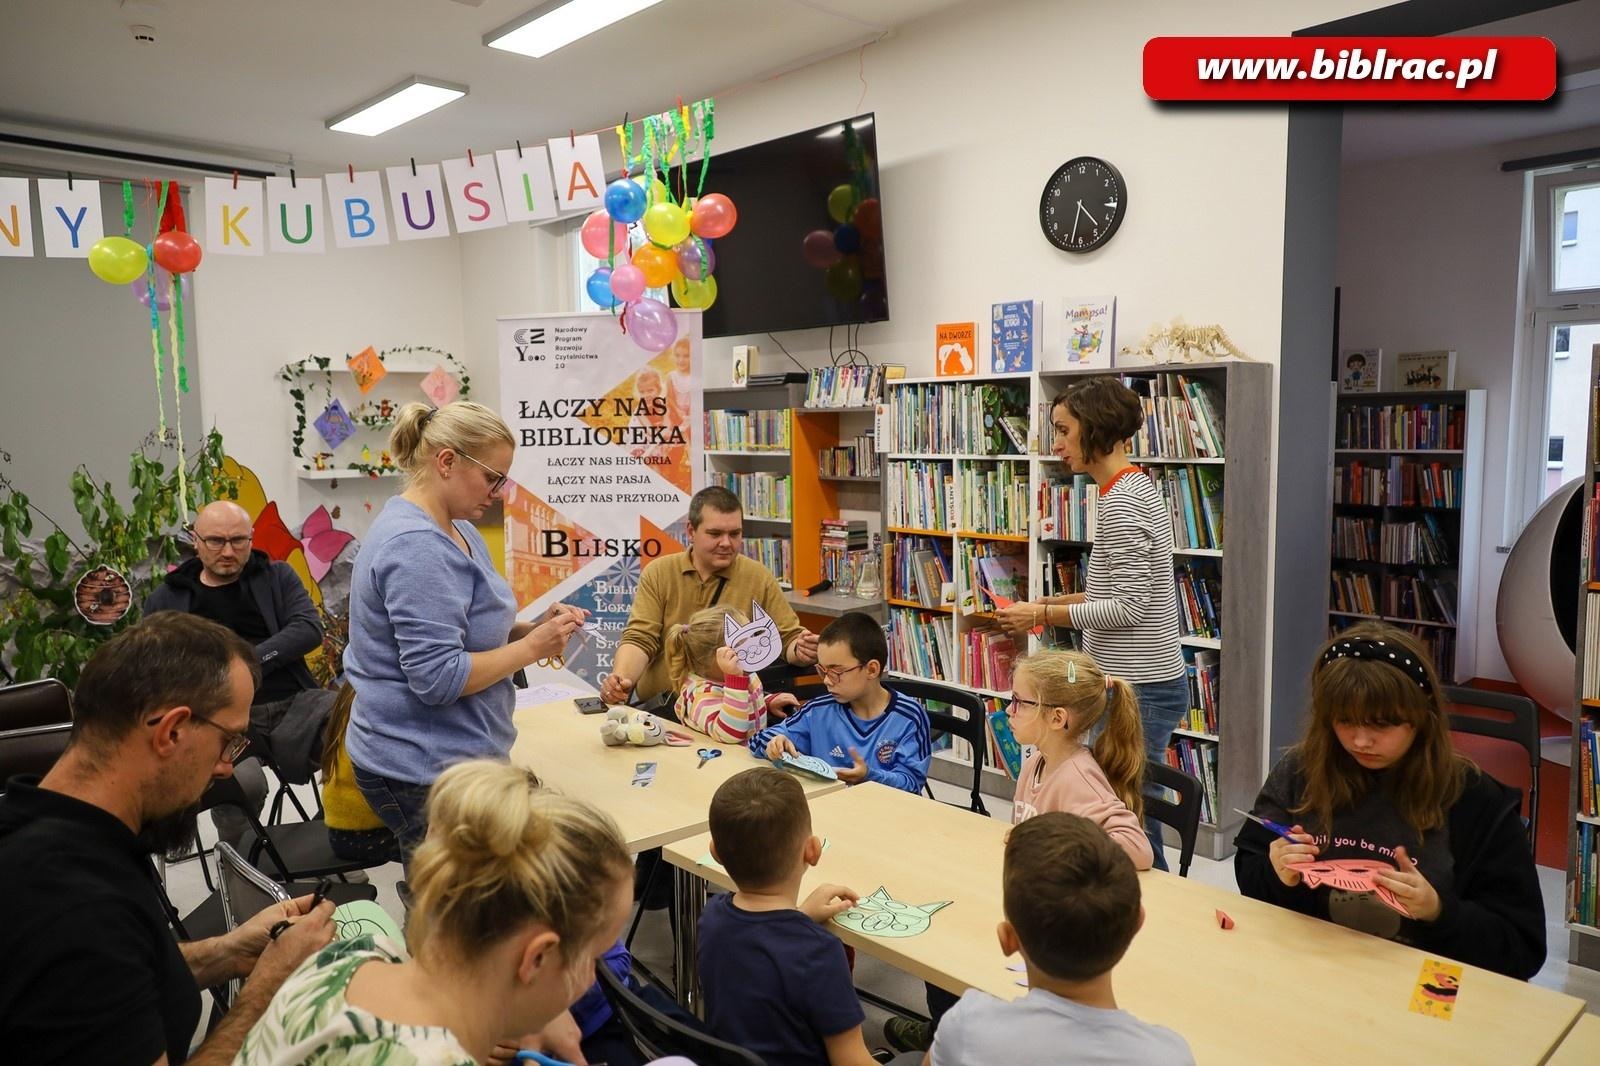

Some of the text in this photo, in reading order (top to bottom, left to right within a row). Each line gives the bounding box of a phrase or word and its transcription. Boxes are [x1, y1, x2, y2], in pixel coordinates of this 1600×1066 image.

[1078, 166, 1086, 174] 12
[1095, 168, 1099, 176] 1
[1064, 175, 1071, 183] 11
[1104, 179, 1109, 187] 2
[1054, 188, 1061, 196] 10
[0, 161, 600, 249] NY KUBUSIA
[1049, 206, 1055, 215] 9
[1053, 222, 1058, 230] 8
[1093, 228, 1098, 236] 5
[1063, 233, 1069, 241] 7
[1078, 236, 1083, 244] 6
[940, 330, 972, 341] NA DWORZE
[518, 397, 667, 421] ŁĄCZY NAS
[519, 425, 687, 447] BIBLIOTEKA
[547, 456, 673, 468] ŁĄCZY NAS HISTORIA
[547, 474, 652, 486] ŁĄCZY NAS PASJA
[547, 493, 680, 505] ŁĄCZY NAS PRZYRODA
[541, 529, 662, 558] BLISKO
[1334, 837, 1357, 848] you
[1360, 838, 1375, 851] be
